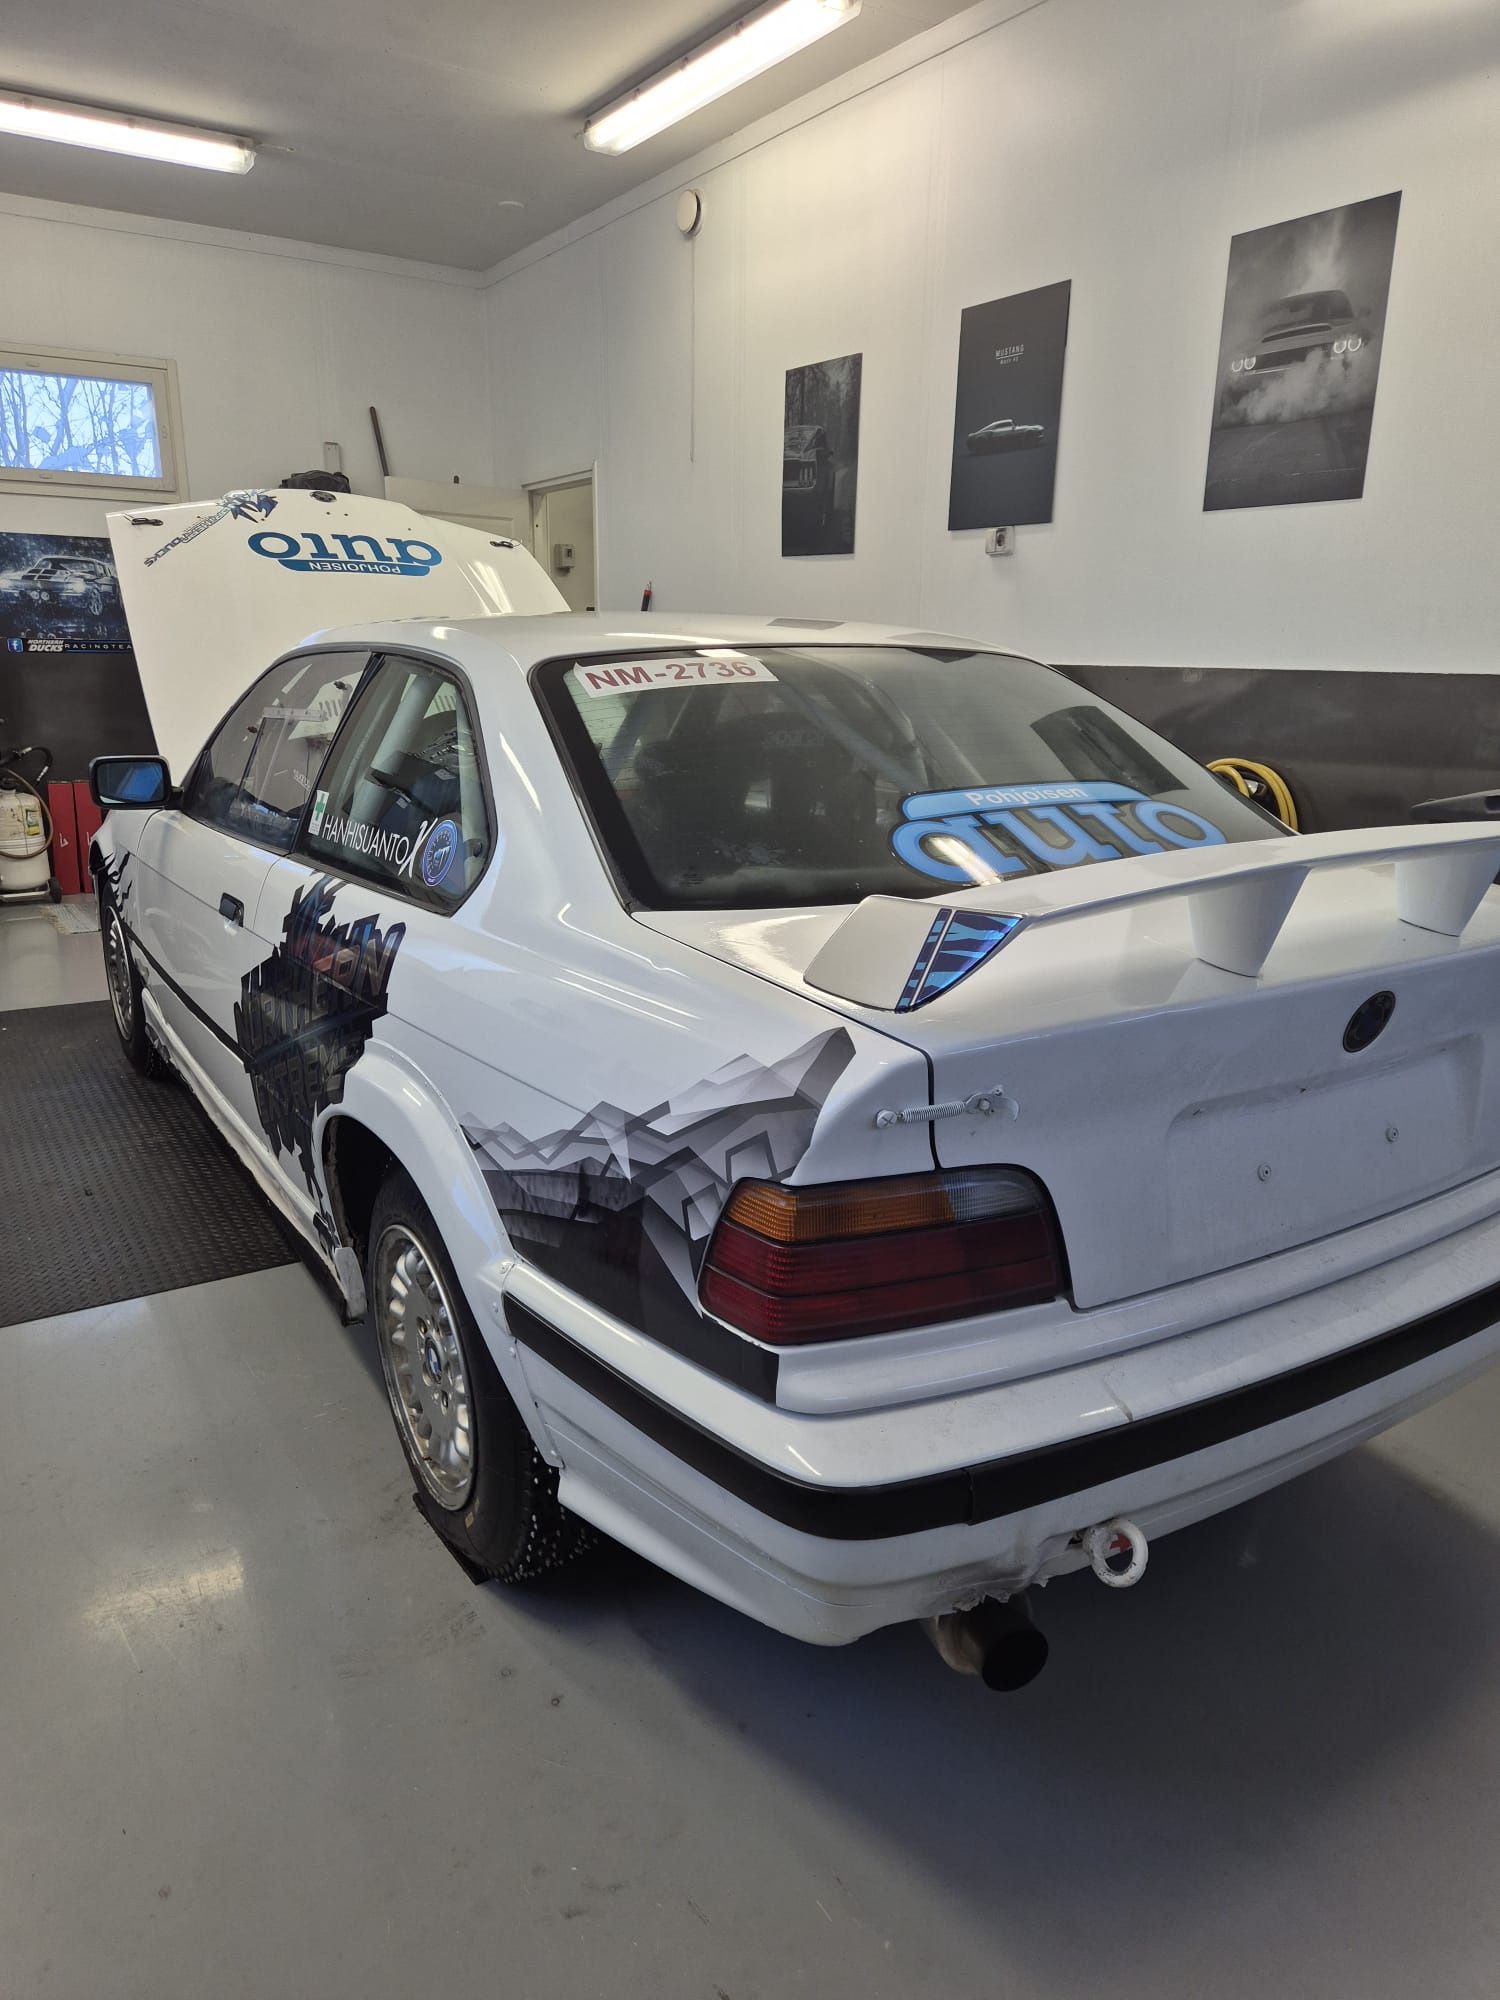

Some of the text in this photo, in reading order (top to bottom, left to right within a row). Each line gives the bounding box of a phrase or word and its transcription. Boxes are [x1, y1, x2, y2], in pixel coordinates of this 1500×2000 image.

[995, 344, 1024, 357] MUSTANG
[309, 561, 401, 574] POHJOISEN
[28, 644, 64, 652] DUCKS
[584, 661, 757, 690] NM-2736
[965, 784, 1088, 808] Pohjoisen
[321, 814, 409, 865] HANHISUANTO
